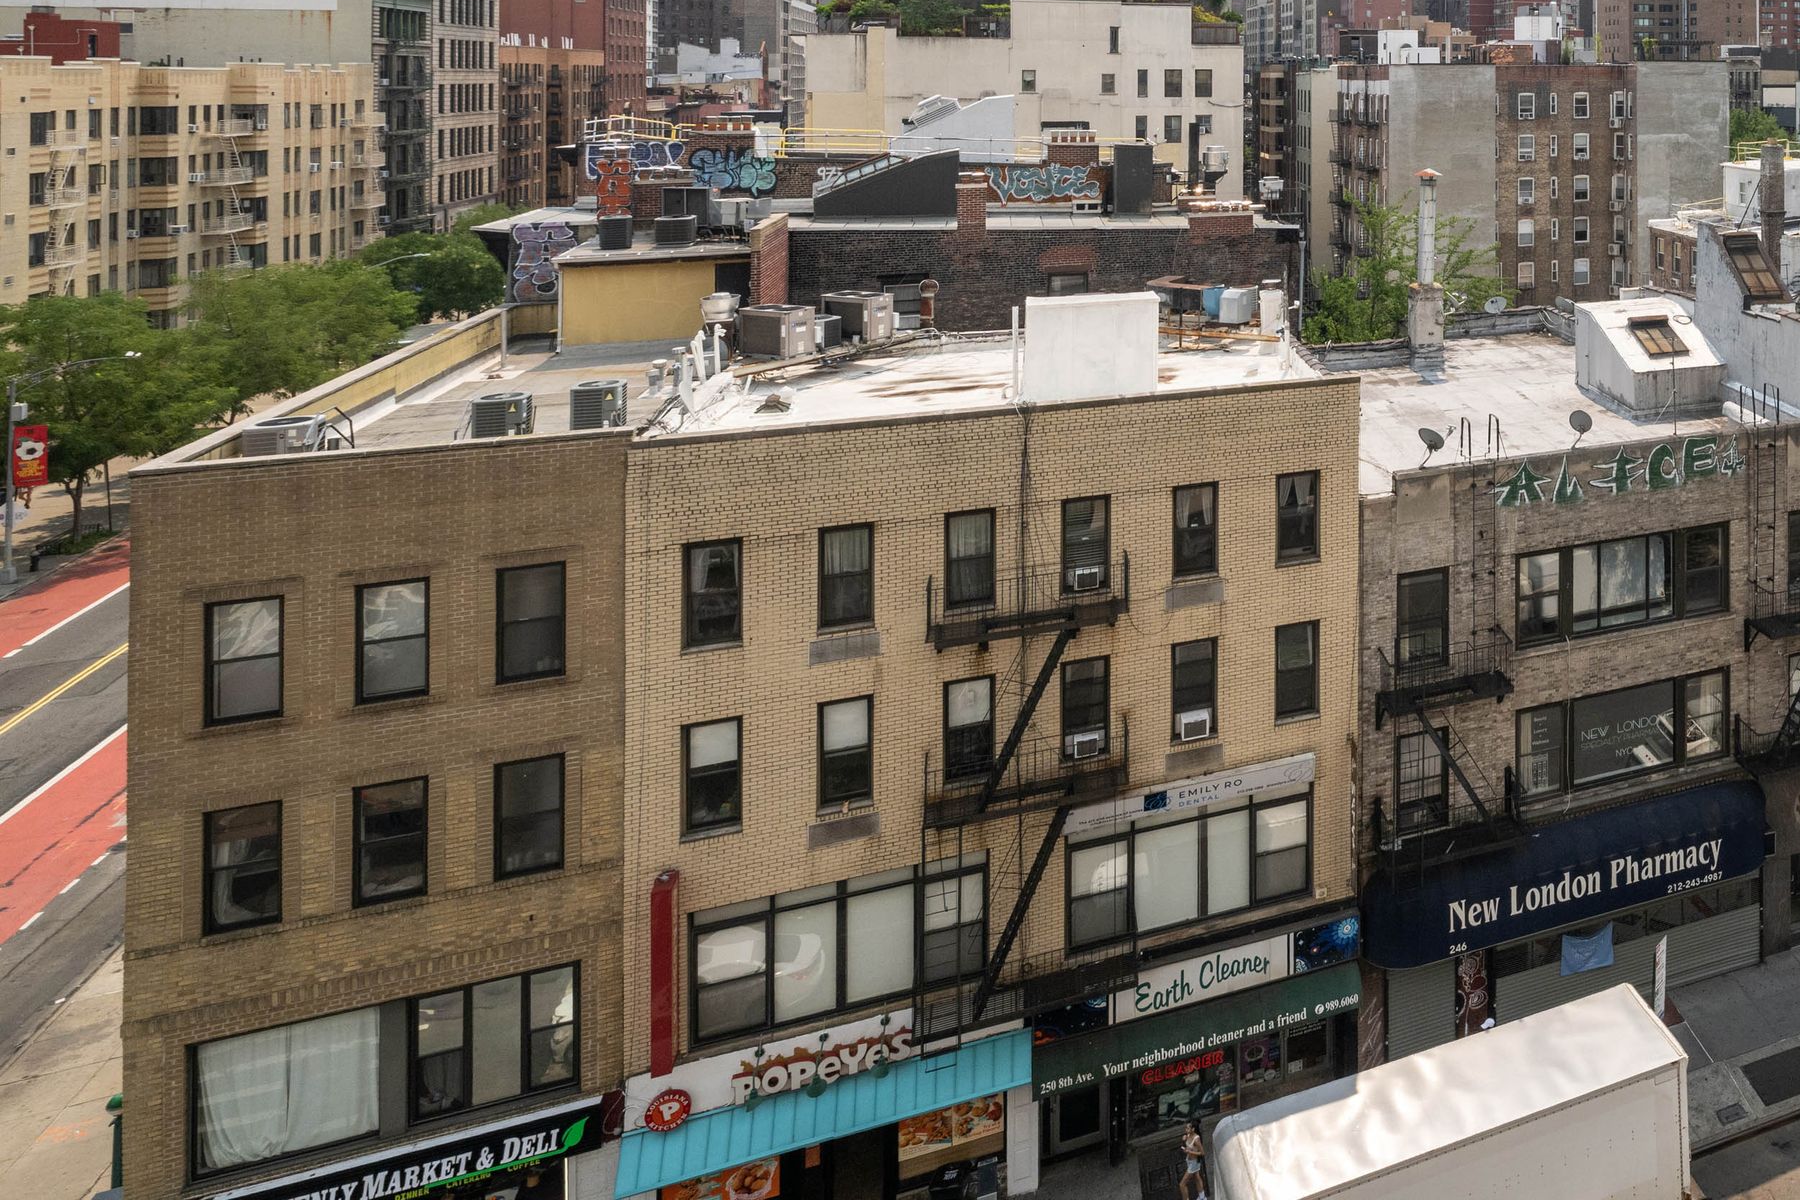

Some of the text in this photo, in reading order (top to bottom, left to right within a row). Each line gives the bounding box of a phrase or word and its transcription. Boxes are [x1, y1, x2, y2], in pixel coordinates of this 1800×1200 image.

[1581, 714, 1660, 742] NEW LONDO
[1615, 747, 1633, 758] NYC
[1178, 783, 1220, 799] EMILY
[1224, 778, 1243, 790] RO
[1178, 794, 1220, 808] DENTAL
[1449, 839, 1723, 934] New London Pharmacy
[1667, 871, 1723, 894] 212-243-4987
[1450, 942, 1467, 954] 246
[1135, 954, 1270, 1012] Earth Cleaner
[1102, 1058, 1130, 1077] Your
[1132, 1035, 1205, 1067] neighborhood
[1207, 1028, 1245, 1047] cleaner
[1247, 1019, 1266, 1036] and
[1268, 1020, 1275, 1030] a
[1277, 1007, 1307, 1027] friend
[1141, 1049, 1225, 1085] CLEANER
[1040, 1071, 1095, 1095] 250 8th Ave.
[360, 1151, 473, 1200] MARKET
[475, 1146, 495, 1171] &
[500, 1128, 560, 1165] DELI
